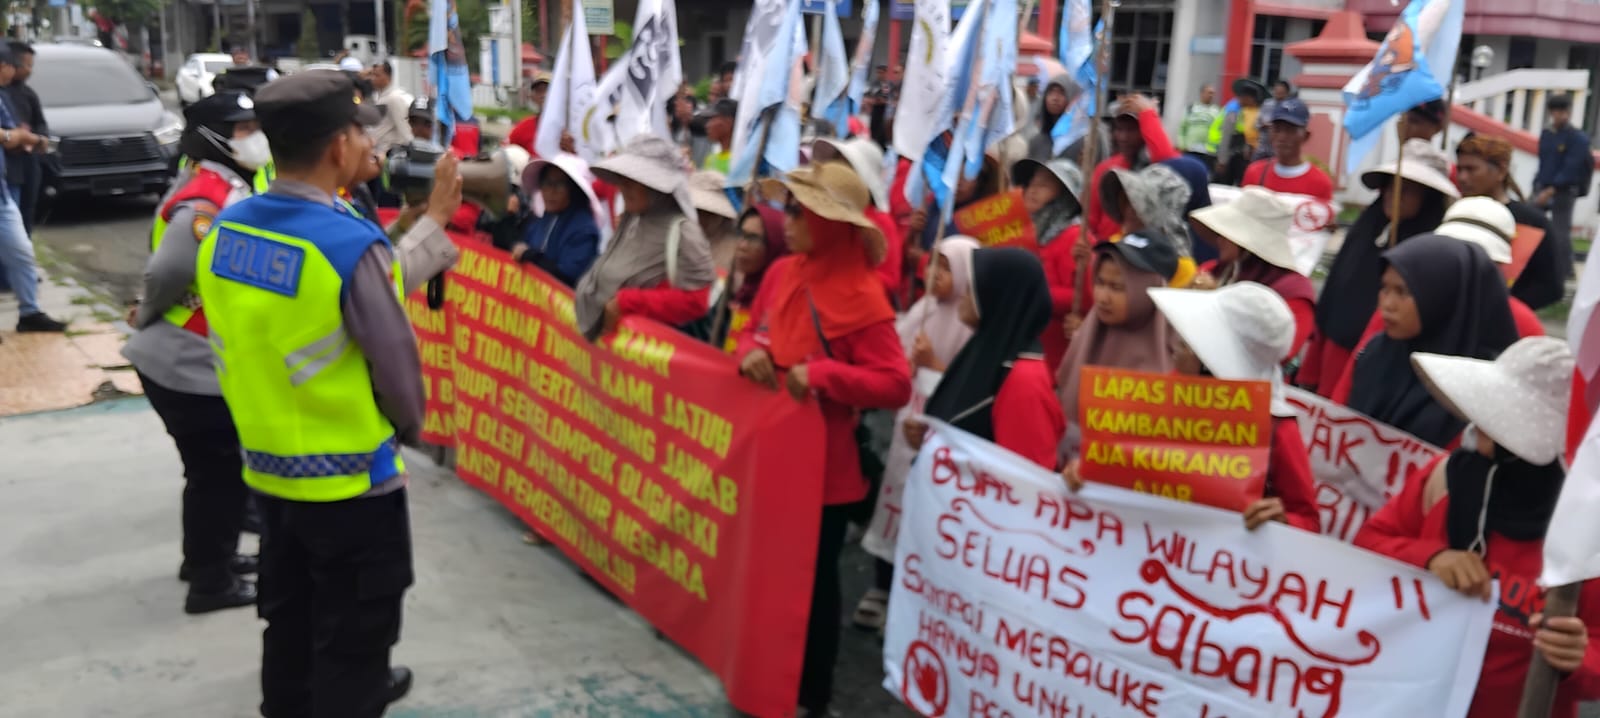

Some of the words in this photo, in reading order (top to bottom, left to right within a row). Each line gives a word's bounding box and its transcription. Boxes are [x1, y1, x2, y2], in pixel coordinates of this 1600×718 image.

[214, 234, 299, 288] POLISI
[485, 297, 541, 348] TANAH
[601, 361, 654, 417] KAMI
[662, 392, 733, 459] JATUH
[612, 325, 675, 378] KAMI
[1093, 375, 1166, 404] LAPAS
[1173, 383, 1252, 411] NUSA
[475, 332, 525, 379] TIDAK
[661, 441, 738, 516] JAWAB
[501, 385, 618, 486] SEKELOMPOK
[618, 463, 719, 559] OLIGARKI
[1086, 407, 1258, 446] KAMBANGAN
[1086, 441, 1127, 466] AJA
[1133, 446, 1251, 480] KURANG
[476, 412, 525, 460] OLEH
[527, 443, 612, 531] APARATUR
[613, 510, 708, 601] NEGARA
[1034, 490, 1124, 546] APA
[1144, 522, 1355, 629] WILAYAH
[917, 609, 1000, 688] HANYA
[935, 513, 1089, 609] SELUAS
[1109, 590, 1344, 718] Sabang
